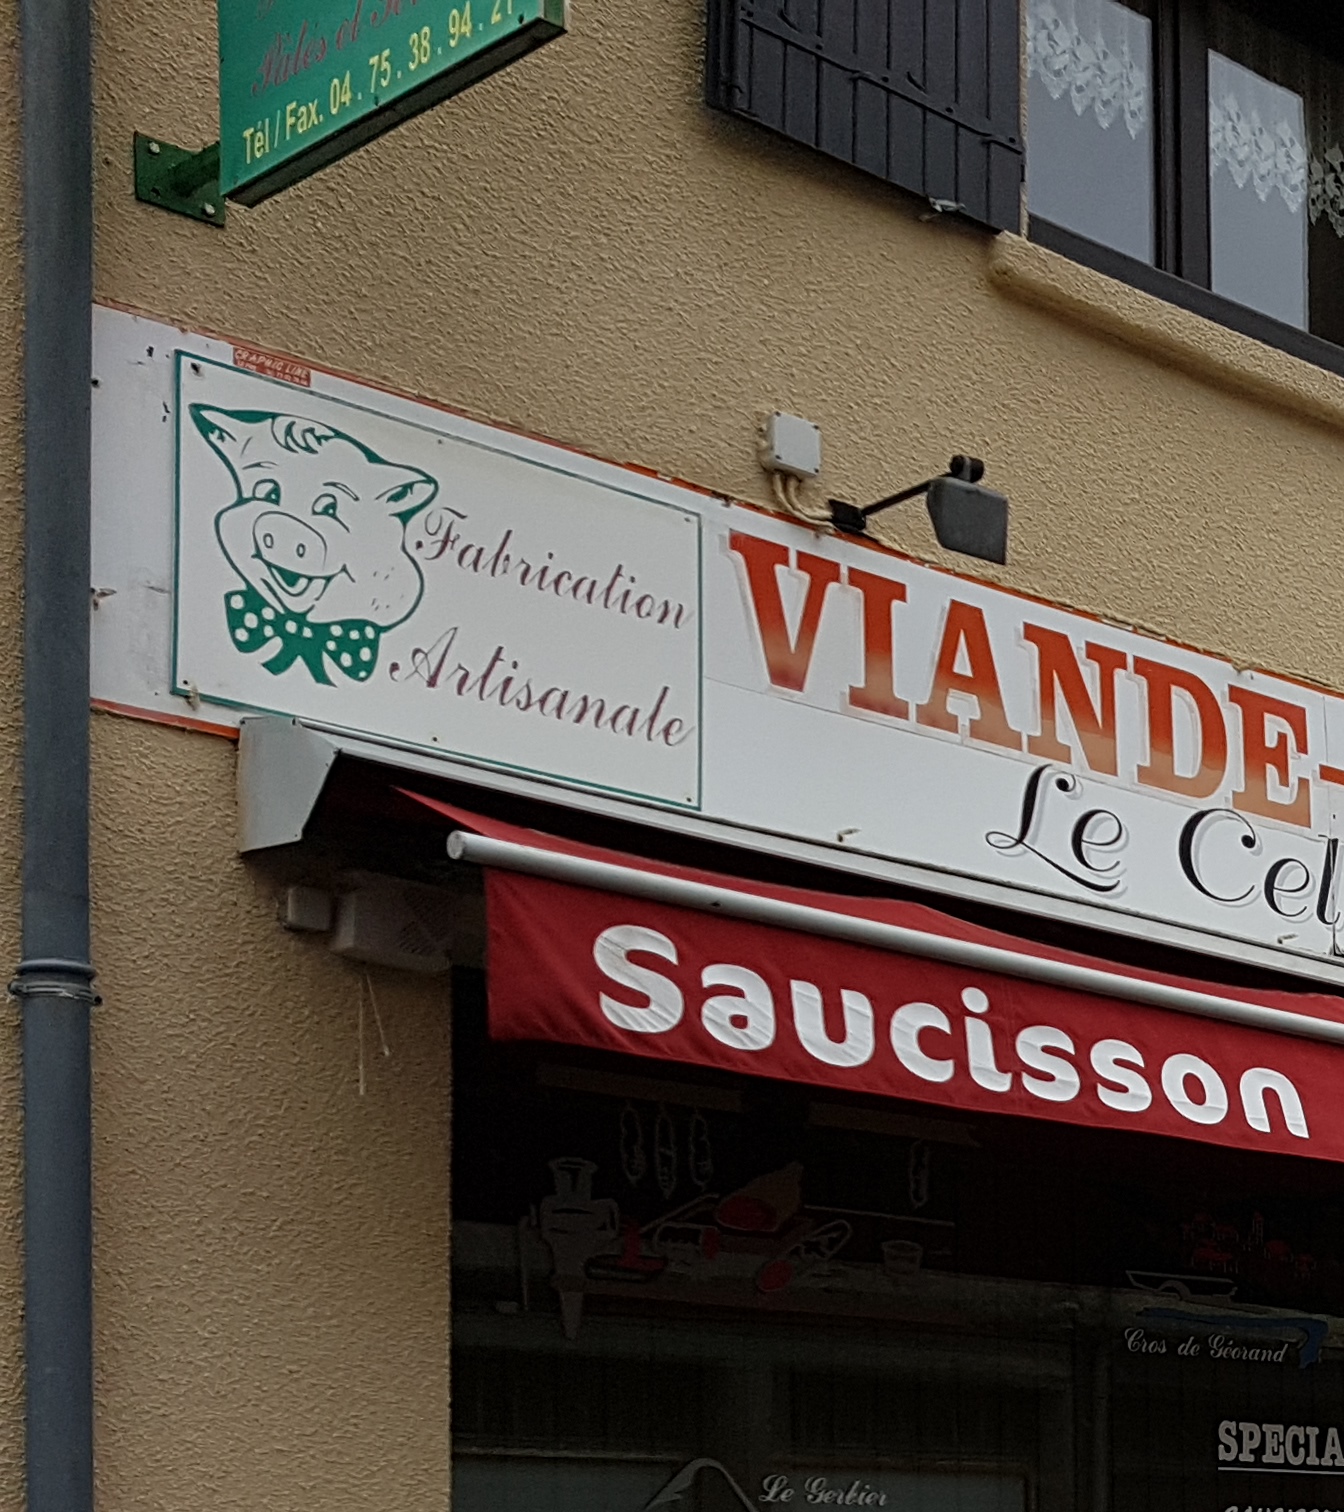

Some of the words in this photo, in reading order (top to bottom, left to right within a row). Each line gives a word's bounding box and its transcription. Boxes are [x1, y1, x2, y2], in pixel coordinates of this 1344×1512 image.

[329, 70, 352, 115] 04
[368, 48, 391, 93] 75
[408, 26, 431, 71] 38
[448, 1, 471, 47] 94
[415, 506, 690, 631] Fabrication
[390, 626, 693, 748] Artisanale
[985, 762, 1122, 893] Le
[594, 922, 1310, 1140] Saucisson
[1124, 1327, 1167, 1353] Cros
[1177, 1336, 1200, 1356] de
[1208, 1333, 1289, 1362] Géorand
[761, 1473, 795, 1504] Le
[804, 1475, 888, 1507] Gerbier
